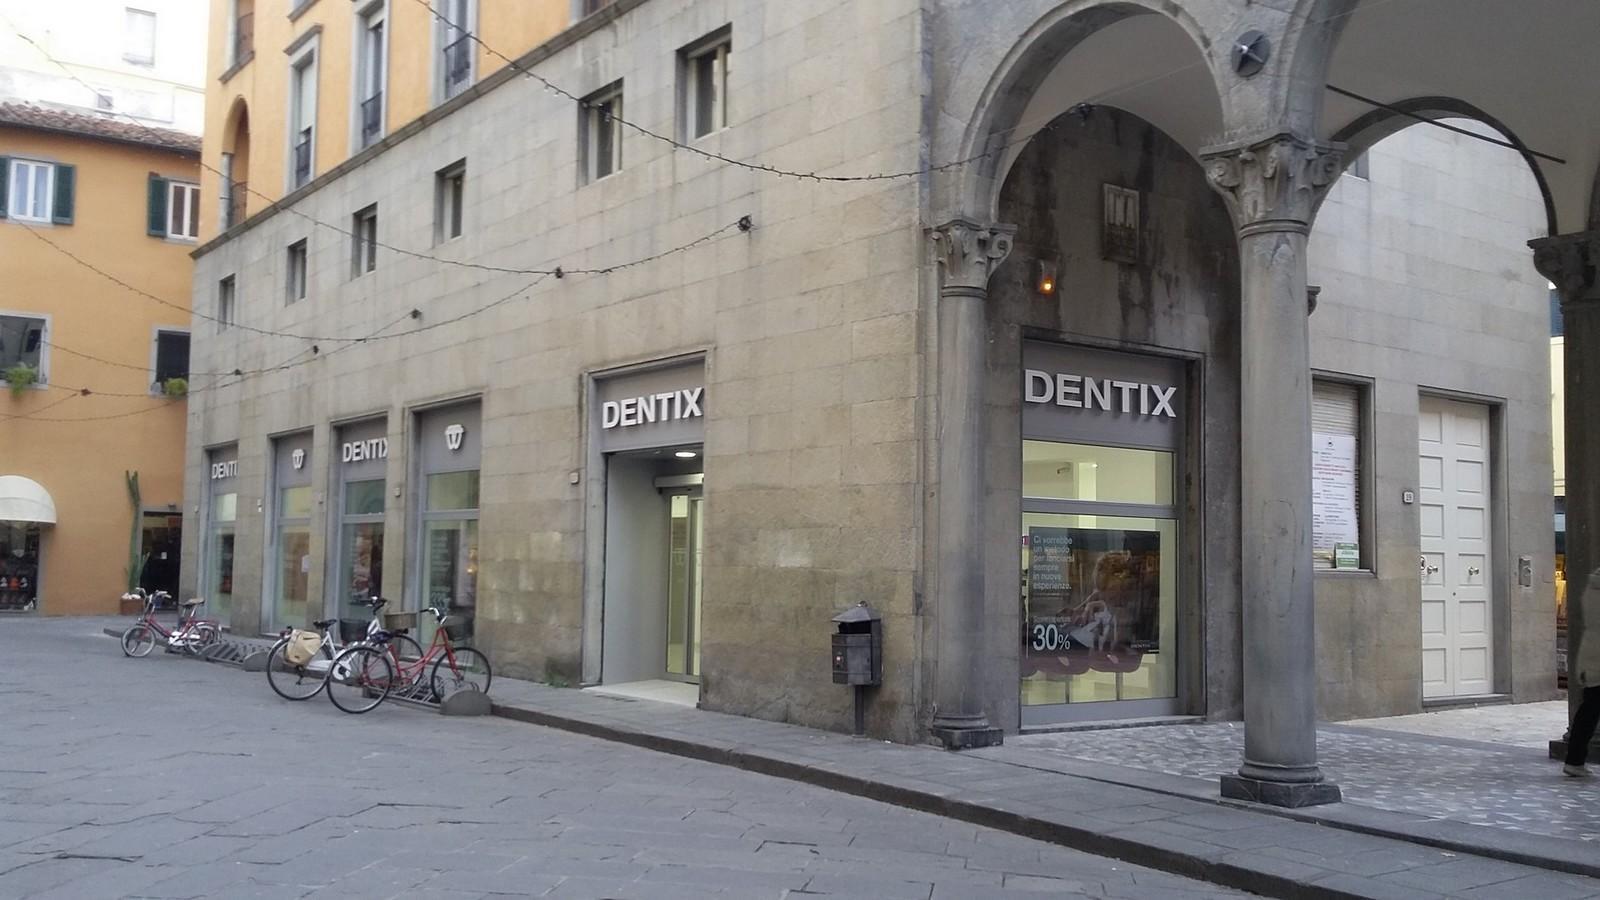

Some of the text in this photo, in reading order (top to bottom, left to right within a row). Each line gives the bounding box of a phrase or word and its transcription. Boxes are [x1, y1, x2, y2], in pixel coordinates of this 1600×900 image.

[602, 387, 704, 429] DENTIX
[1024, 368, 1177, 418] DENTIX
[1033, 624, 1070, 651] 30%
